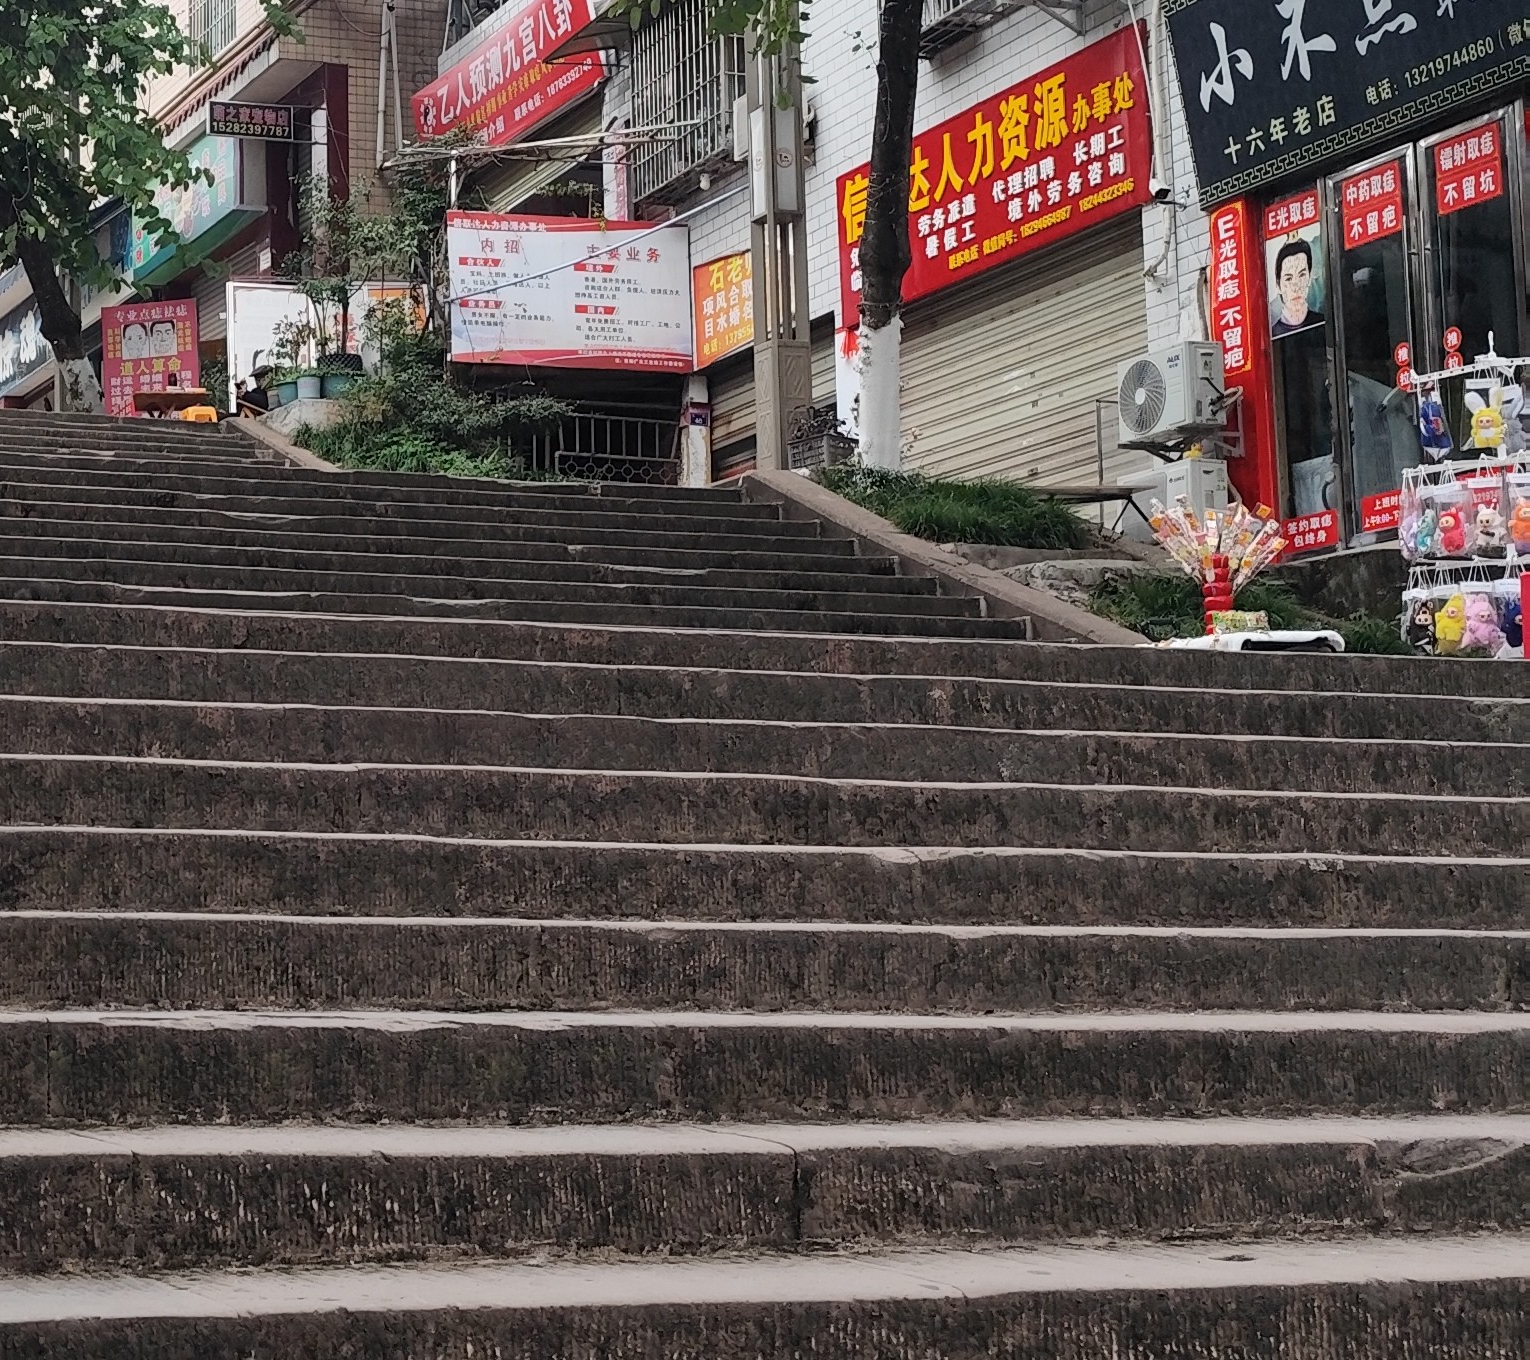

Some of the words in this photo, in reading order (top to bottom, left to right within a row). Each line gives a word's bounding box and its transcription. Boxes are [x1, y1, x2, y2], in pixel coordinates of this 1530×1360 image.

[213, 121, 289, 137] 15282397787
[1223, 95, 1337, 165] 十六年老店
[917, 193, 977, 238] 劳务派遣
[992, 156, 1056, 203] 代理招聘
[1073, 125, 1125, 166] 长期工
[1346, 170, 1396, 206] 中药取痣
[1444, 169, 1496, 206] 不留坑
[925, 220, 977, 258] 暑假工
[1008, 152, 1126, 222] 境外劳务咨询
[1268, 197, 1316, 231] E光取痣
[1350, 205, 1398, 241] 不留疤
[1217, 213, 1241, 302] E光取痣
[1220, 305, 1245, 369] 不留疤
[1447, 331, 1459, 348] 推
[120, 356, 182, 376] 道人算命
[1286, 513, 1332, 534] 签约取痣
[1294, 530, 1328, 547] 包终身
